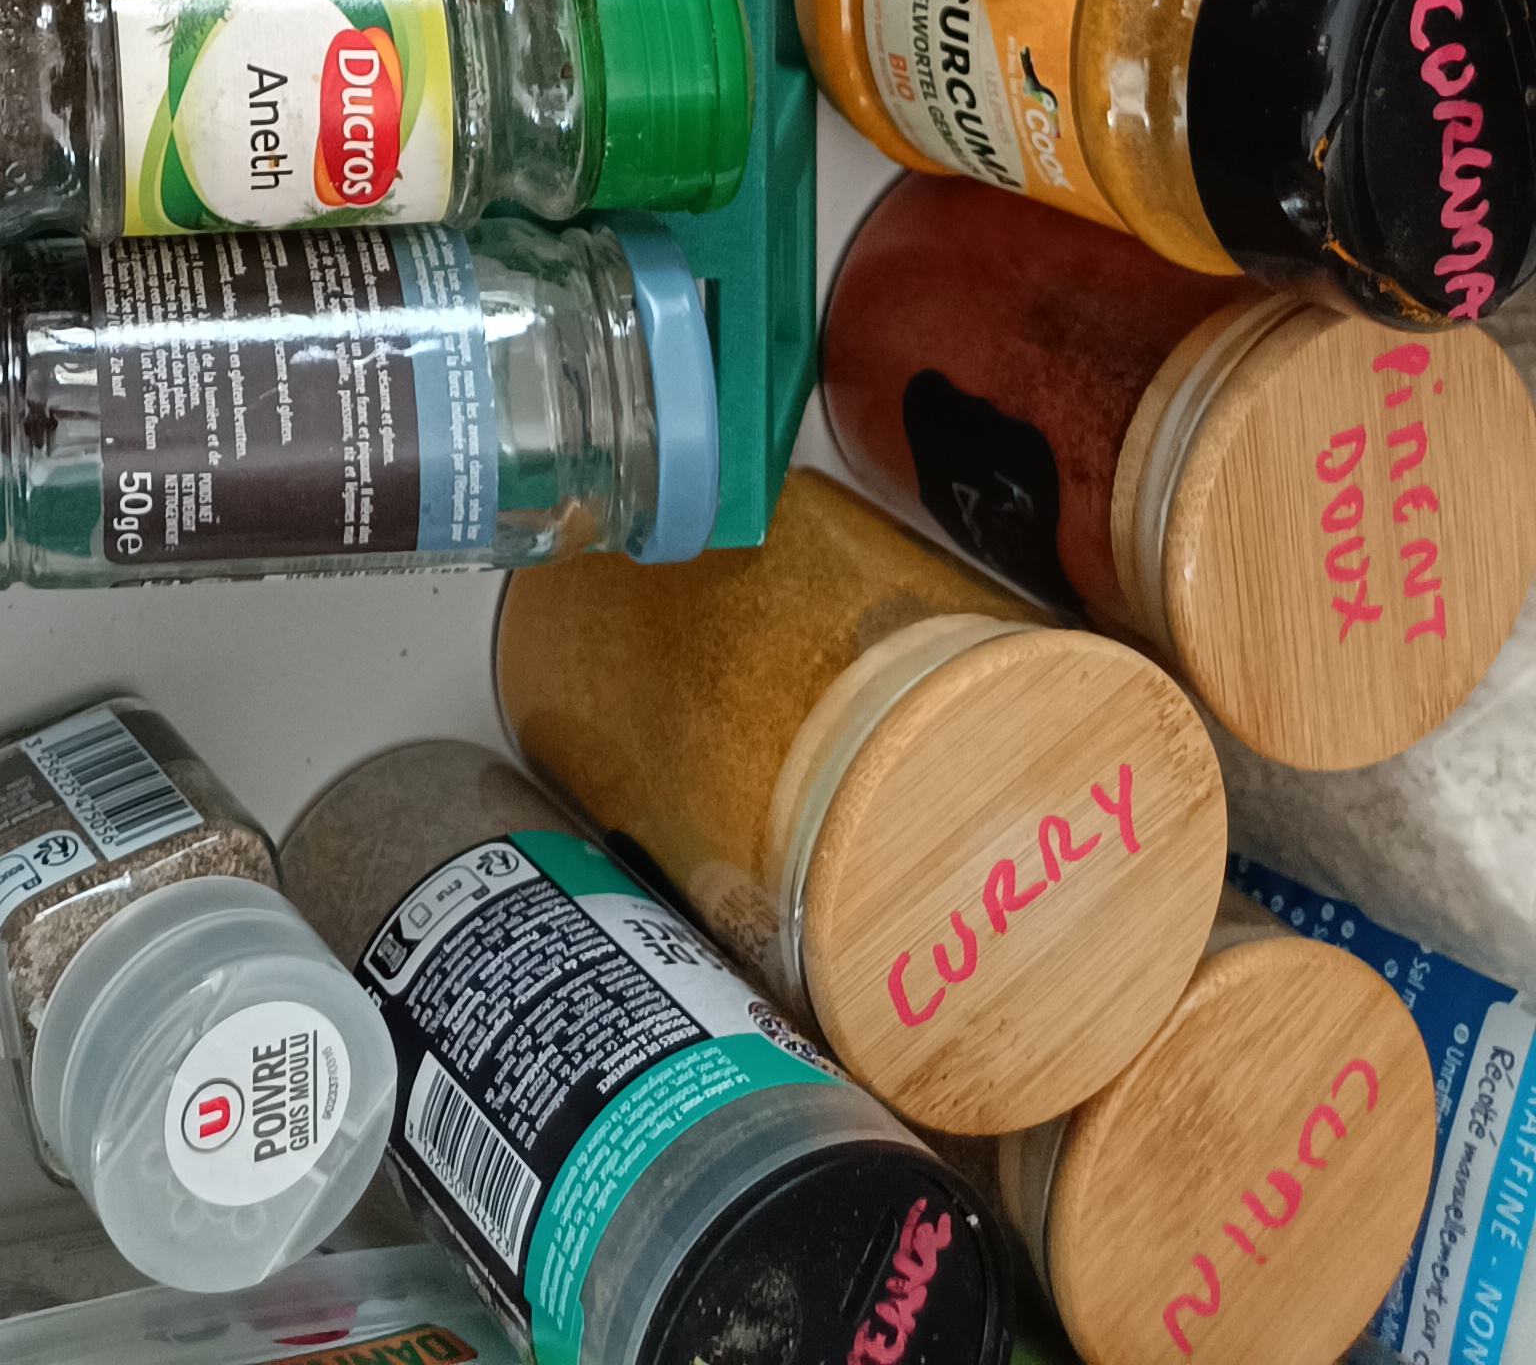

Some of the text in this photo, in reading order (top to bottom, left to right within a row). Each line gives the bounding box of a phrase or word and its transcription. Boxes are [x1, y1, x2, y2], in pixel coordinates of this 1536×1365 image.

[247, 63, 293, 190] Aneth
[337, 49, 381, 195] Ducros
[888, 53, 914, 101] BIO
[381, 413, 392, 424] et
[1315, 424, 1384, 645] DOUX
[886, 764, 1143, 1028] CURRY
[253, 1037, 287, 1162] POIVRE
[289, 1033, 309, 1151] GRIS MOULU
[1466, 1045, 1516, 1140] Récolté
